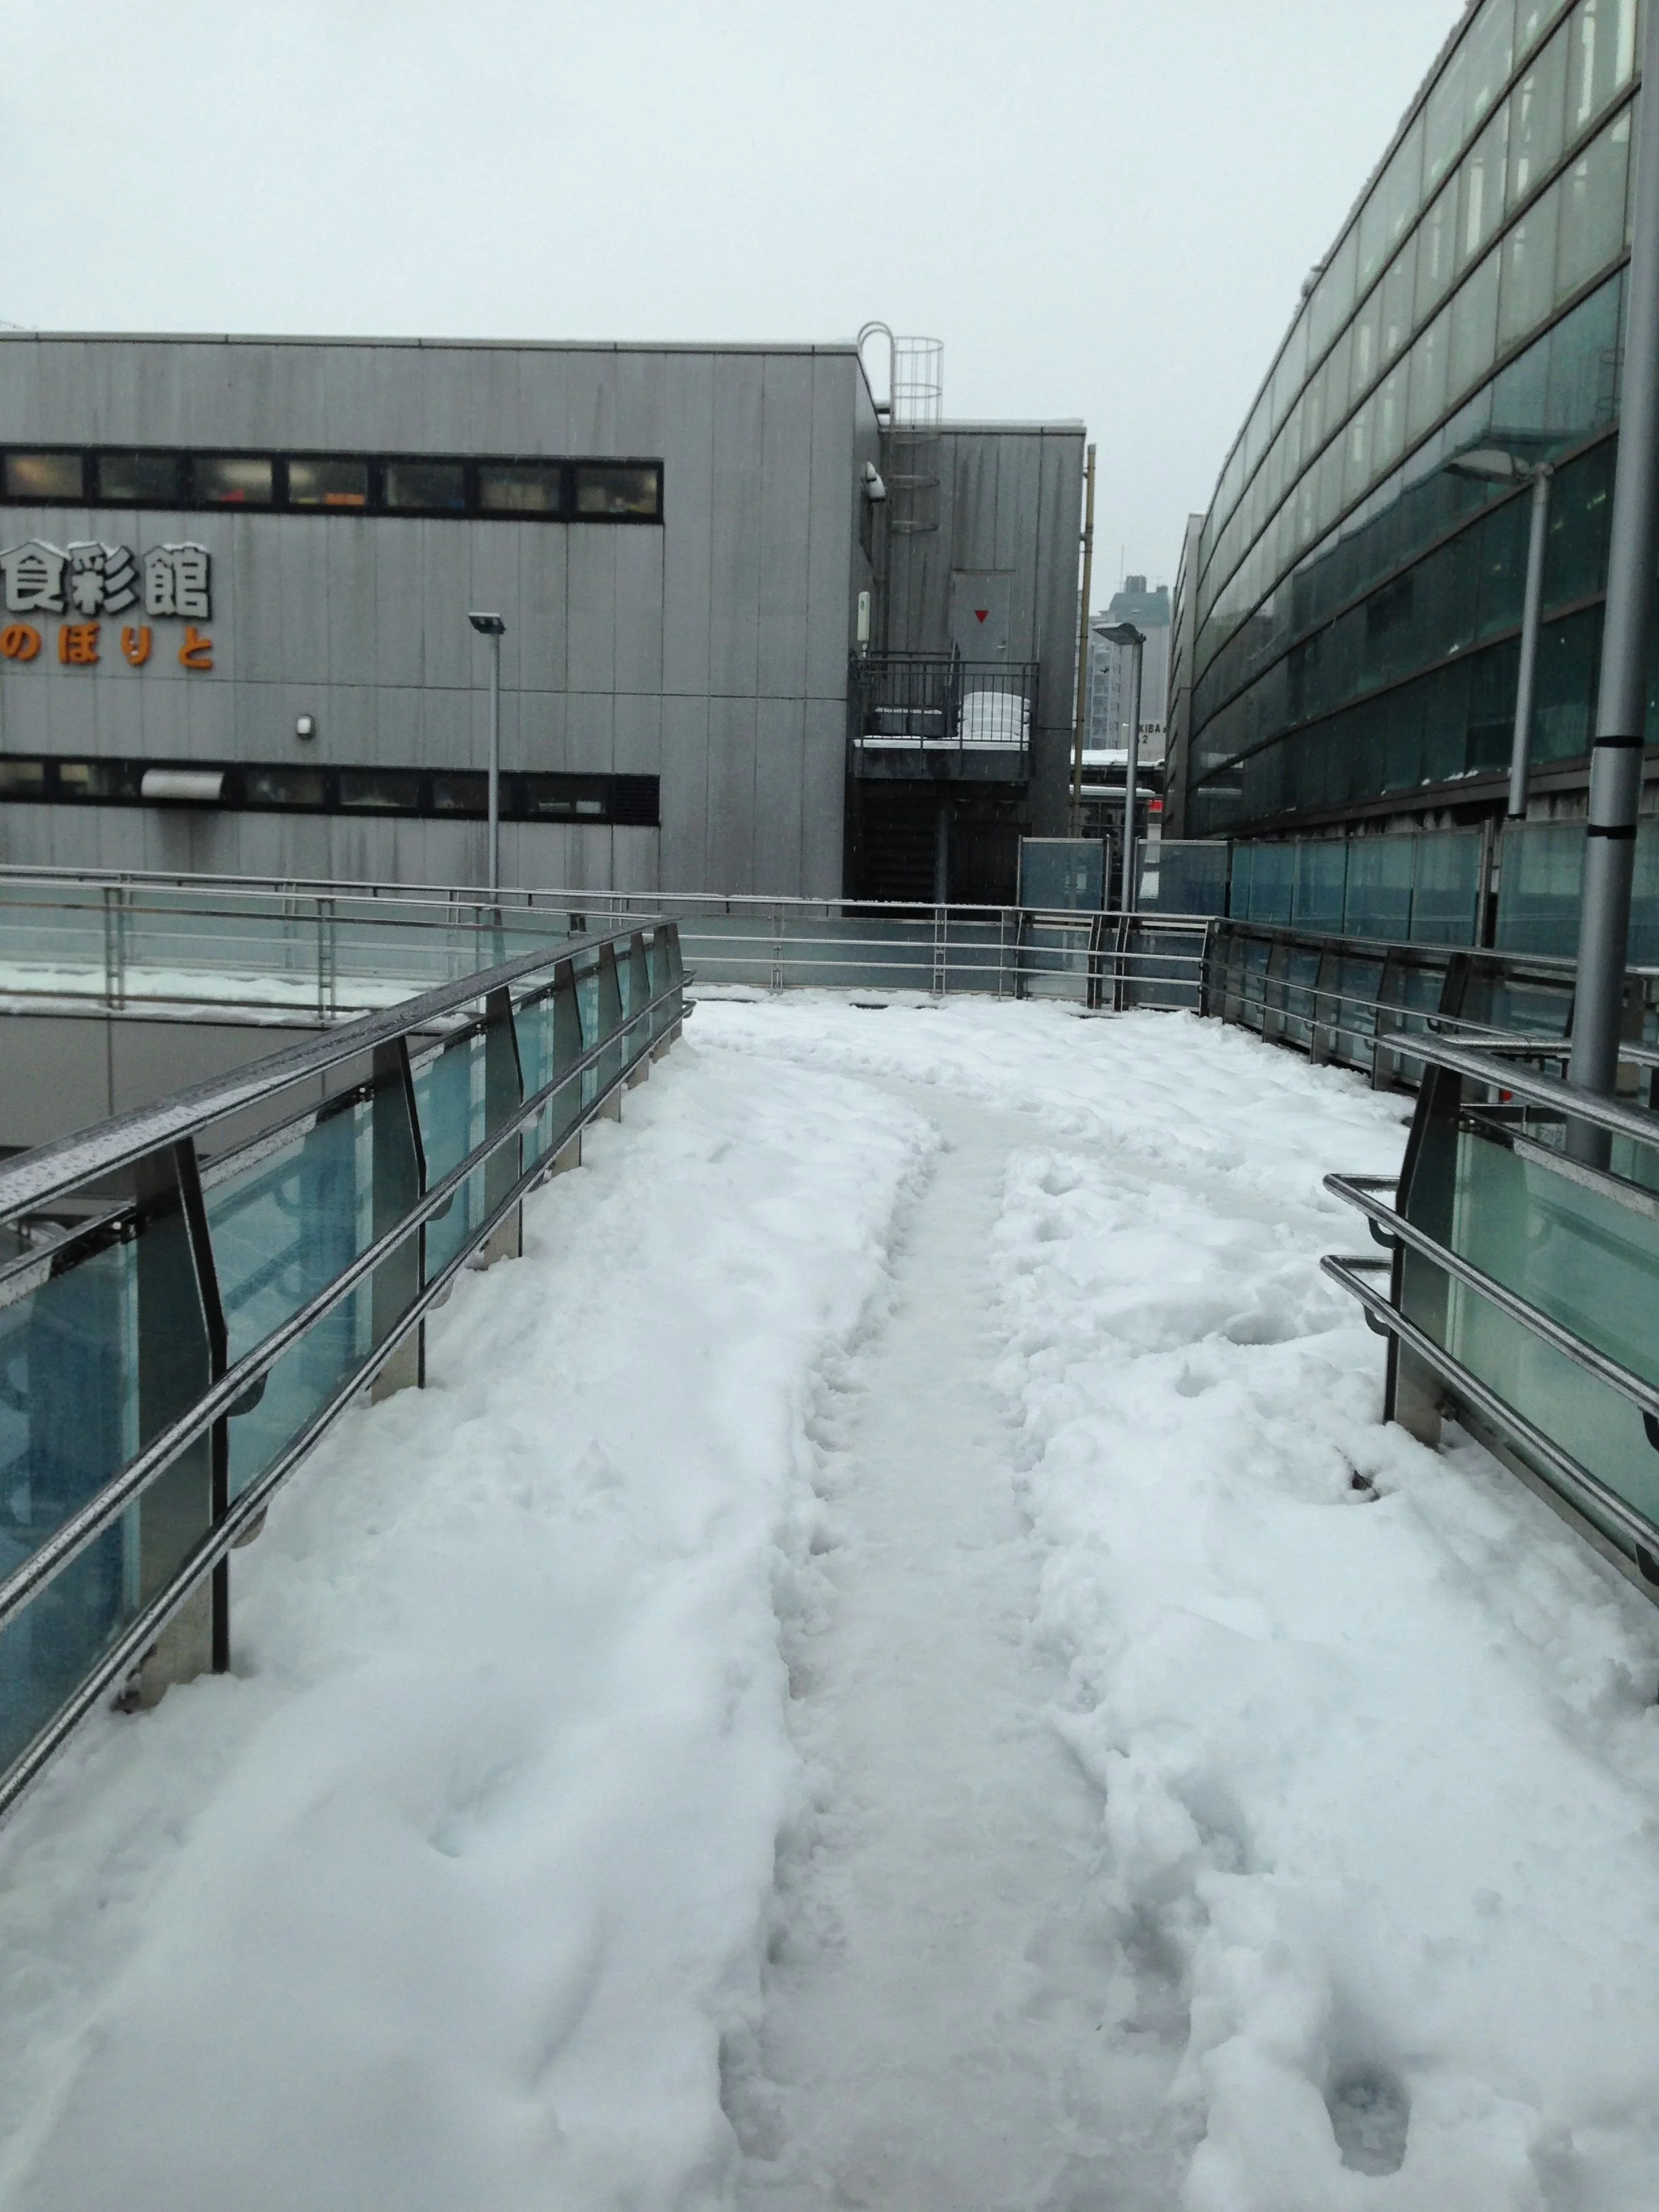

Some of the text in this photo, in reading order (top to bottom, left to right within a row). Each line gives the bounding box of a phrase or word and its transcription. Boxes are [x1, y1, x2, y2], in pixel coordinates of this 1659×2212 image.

[0, 541, 211, 619] 食彩館
[0, 619, 213, 670] のぼりと
